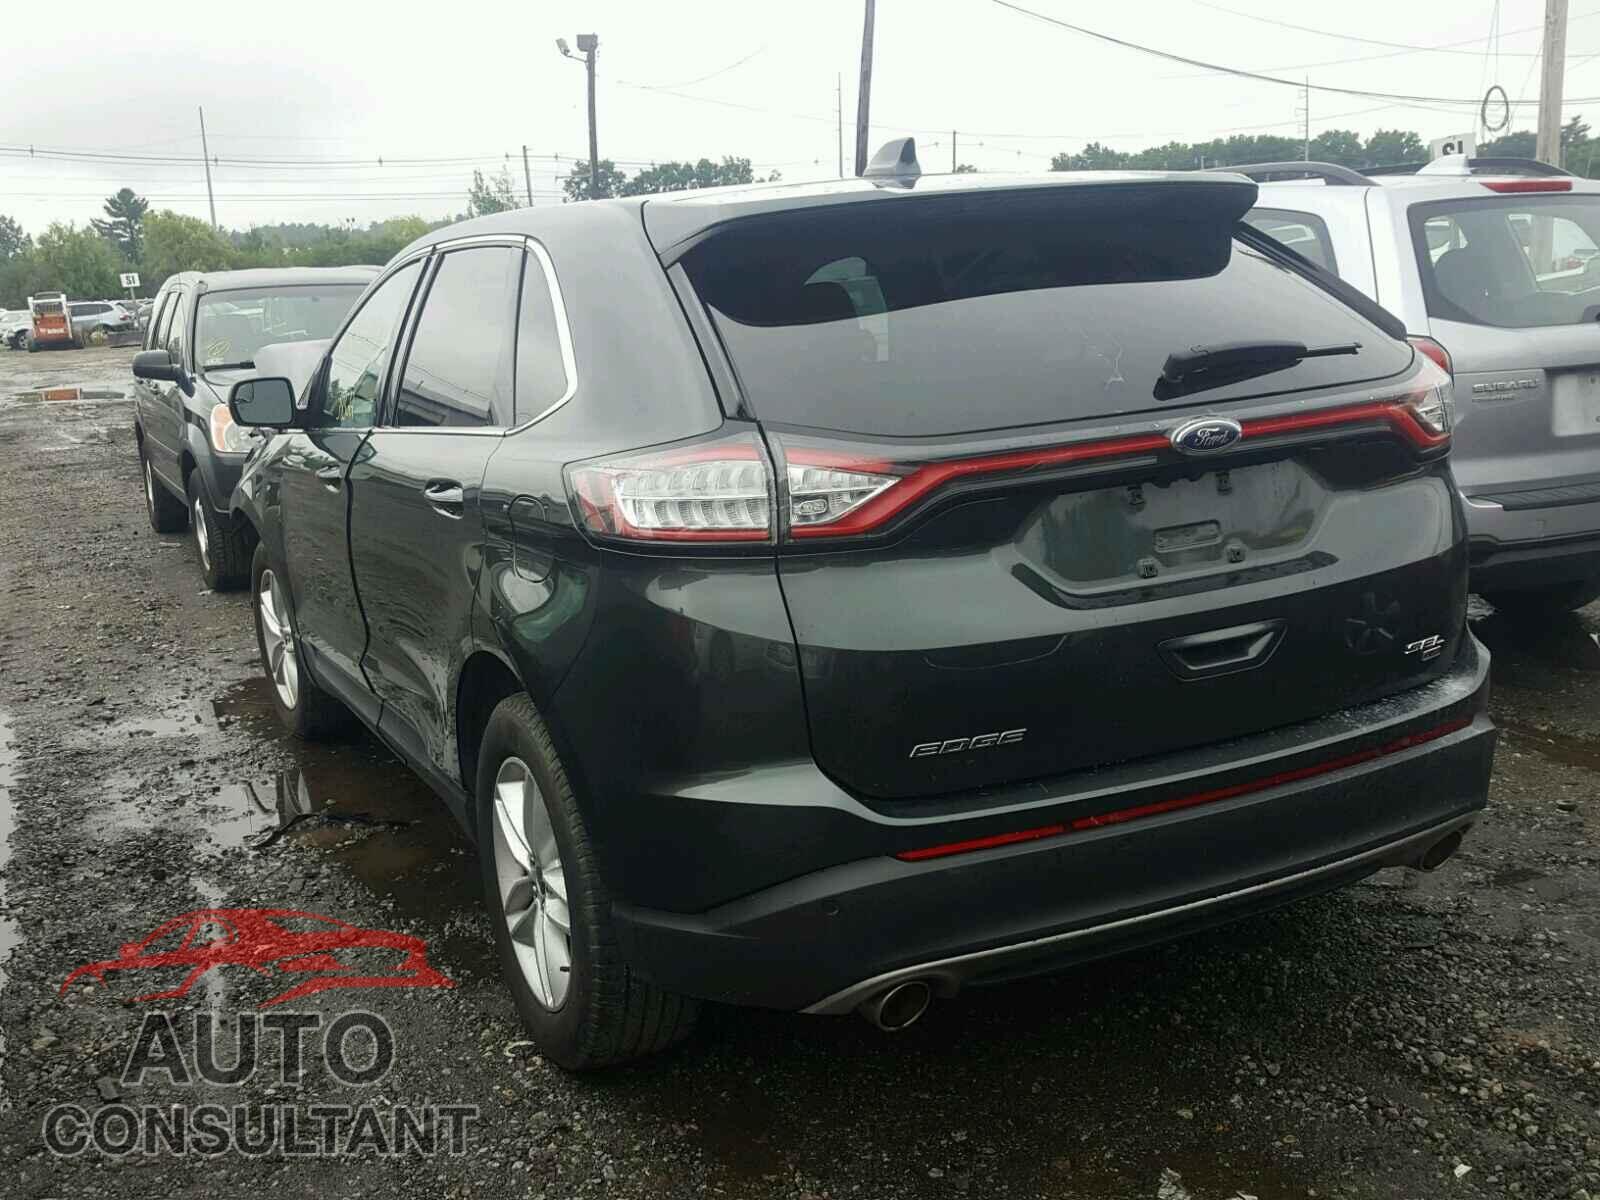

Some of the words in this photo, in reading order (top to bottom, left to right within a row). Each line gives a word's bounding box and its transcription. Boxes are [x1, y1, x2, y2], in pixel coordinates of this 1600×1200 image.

[1472, 378, 1539, 393] SUBARU
[1194, 427, 1229, 449] Ford
[909, 728, 1027, 758] EDGE
